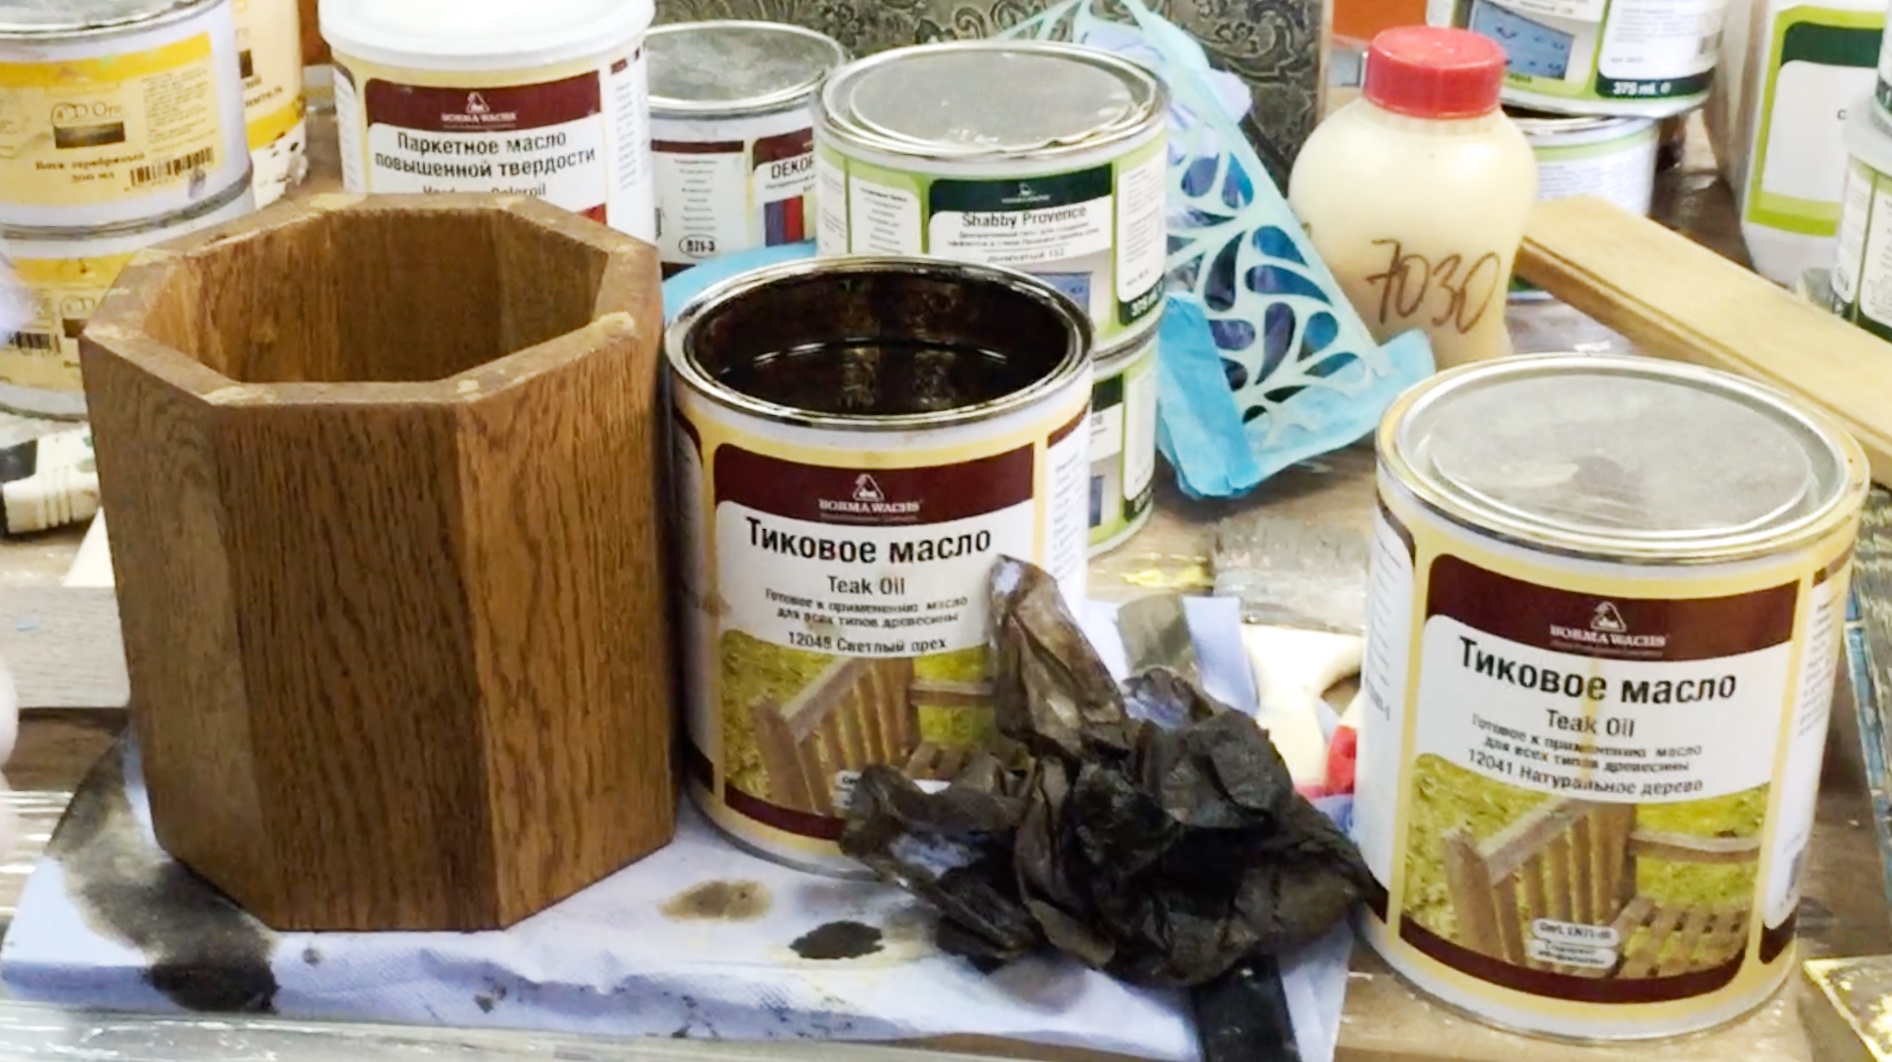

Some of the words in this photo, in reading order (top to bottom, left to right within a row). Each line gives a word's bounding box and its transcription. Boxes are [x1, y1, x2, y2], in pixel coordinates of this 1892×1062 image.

[397, 132, 499, 155] Паркетное
[506, 130, 567, 150] масло
[374, 153, 492, 178] повышенной
[498, 148, 596, 178] твердости
[961, 212, 1017, 230] Shabby
[1022, 205, 1088, 227] Provence
[1364, 238, 1501, 334] 7030
[745, 515, 877, 563] Тиковое
[888, 528, 991, 565] масло
[765, 587, 814, 608] Готовое
[828, 601, 919, 614] применению
[926, 595, 969, 611] масло
[827, 575, 873, 595] Teak
[879, 576, 906, 596] Oil
[776, 607, 799, 621] для
[803, 612, 834, 626] всех
[838, 615, 879, 628] типов
[882, 612, 959, 629] древесины
[837, 637, 905, 654] Светлый
[911, 637, 947, 655] орех
[1457, 635, 1608, 702] Тиковое
[1620, 672, 1737, 705] масло
[1471, 712, 1527, 743] Готовое
[1544, 738, 1647, 758] применению
[1654, 744, 1703, 758] масло
[1546, 708, 1598, 736] Teak
[1605, 716, 1636, 738] Oil
[1483, 736, 1510, 753] для
[1514, 744, 1549, 763] всех
[1553, 752, 1599, 770] типов
[1602, 761, 1690, 774] древесины
[1467, 748, 1514, 775] 12041
[1519, 765, 1637, 795] Натуральное
[1640, 779, 1703, 797] дерево
